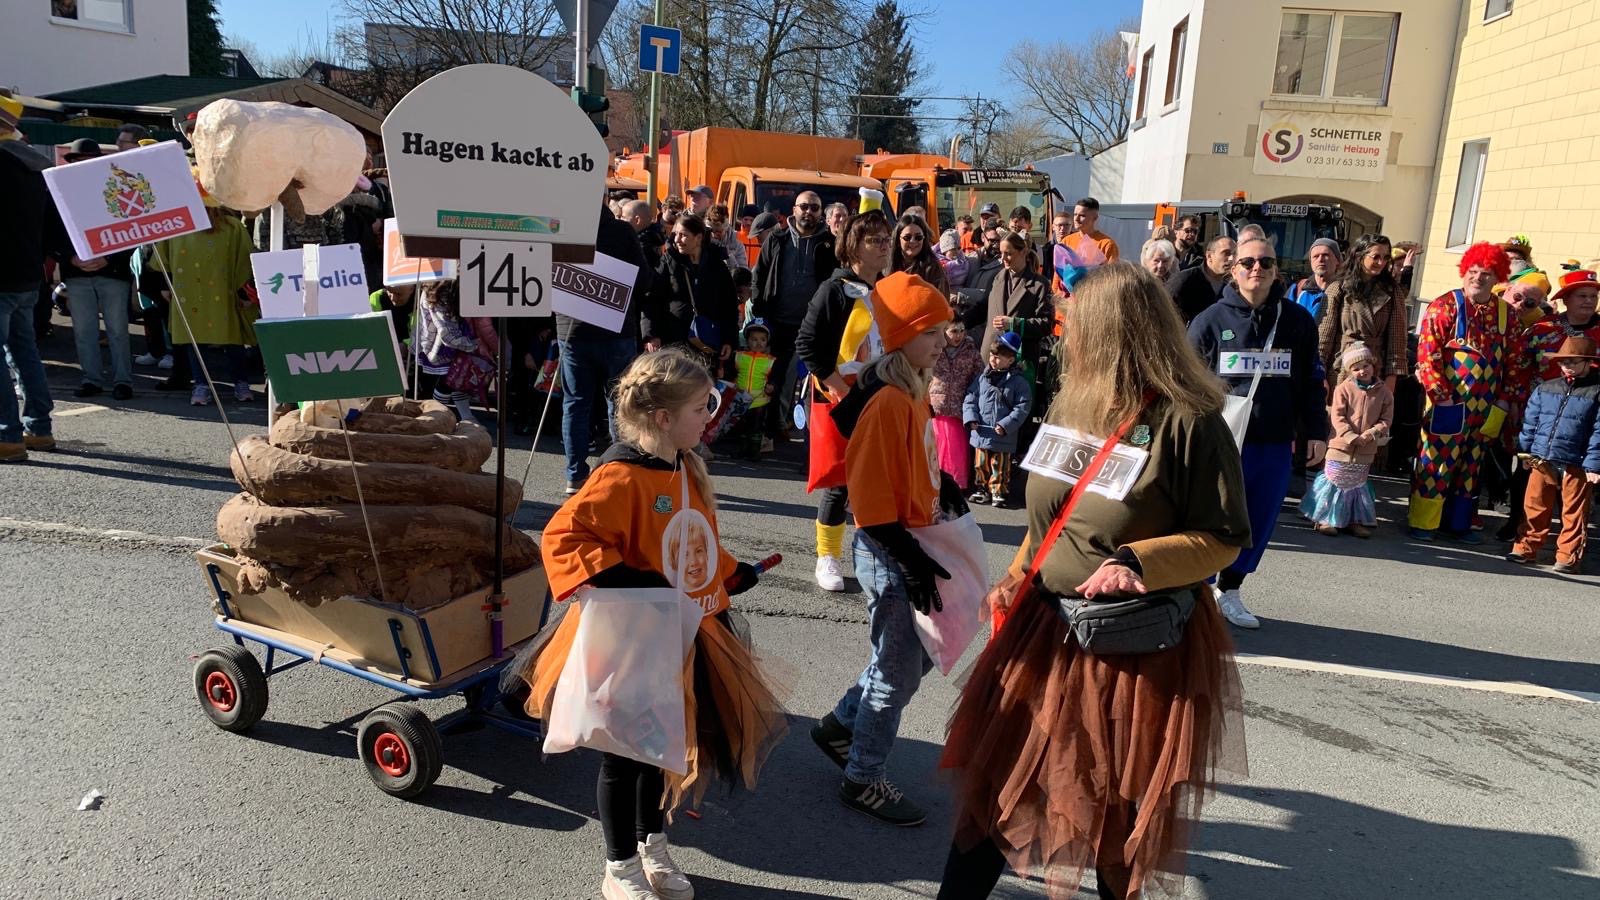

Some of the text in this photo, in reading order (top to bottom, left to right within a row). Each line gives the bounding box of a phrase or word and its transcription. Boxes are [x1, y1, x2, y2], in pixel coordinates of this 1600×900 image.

[1275, 130, 1292, 155] S
[1310, 128, 1382, 141] SCHNETTLER
[402, 132, 594, 172] Hagen kackt ab
[1308, 142, 1380, 156] Sanitär Heizung
[1306, 156, 1312, 164] 0
[1314, 156, 1324, 164] 23
[1343, 157, 1353, 166] 63
[1355, 158, 1365, 167] 33
[1367, 159, 1378, 168] 33
[1267, 204, 1307, 214] HA EB 418
[100, 215, 186, 248] Andreas
[288, 269, 362, 292] Talia
[467, 251, 543, 307] 14b
